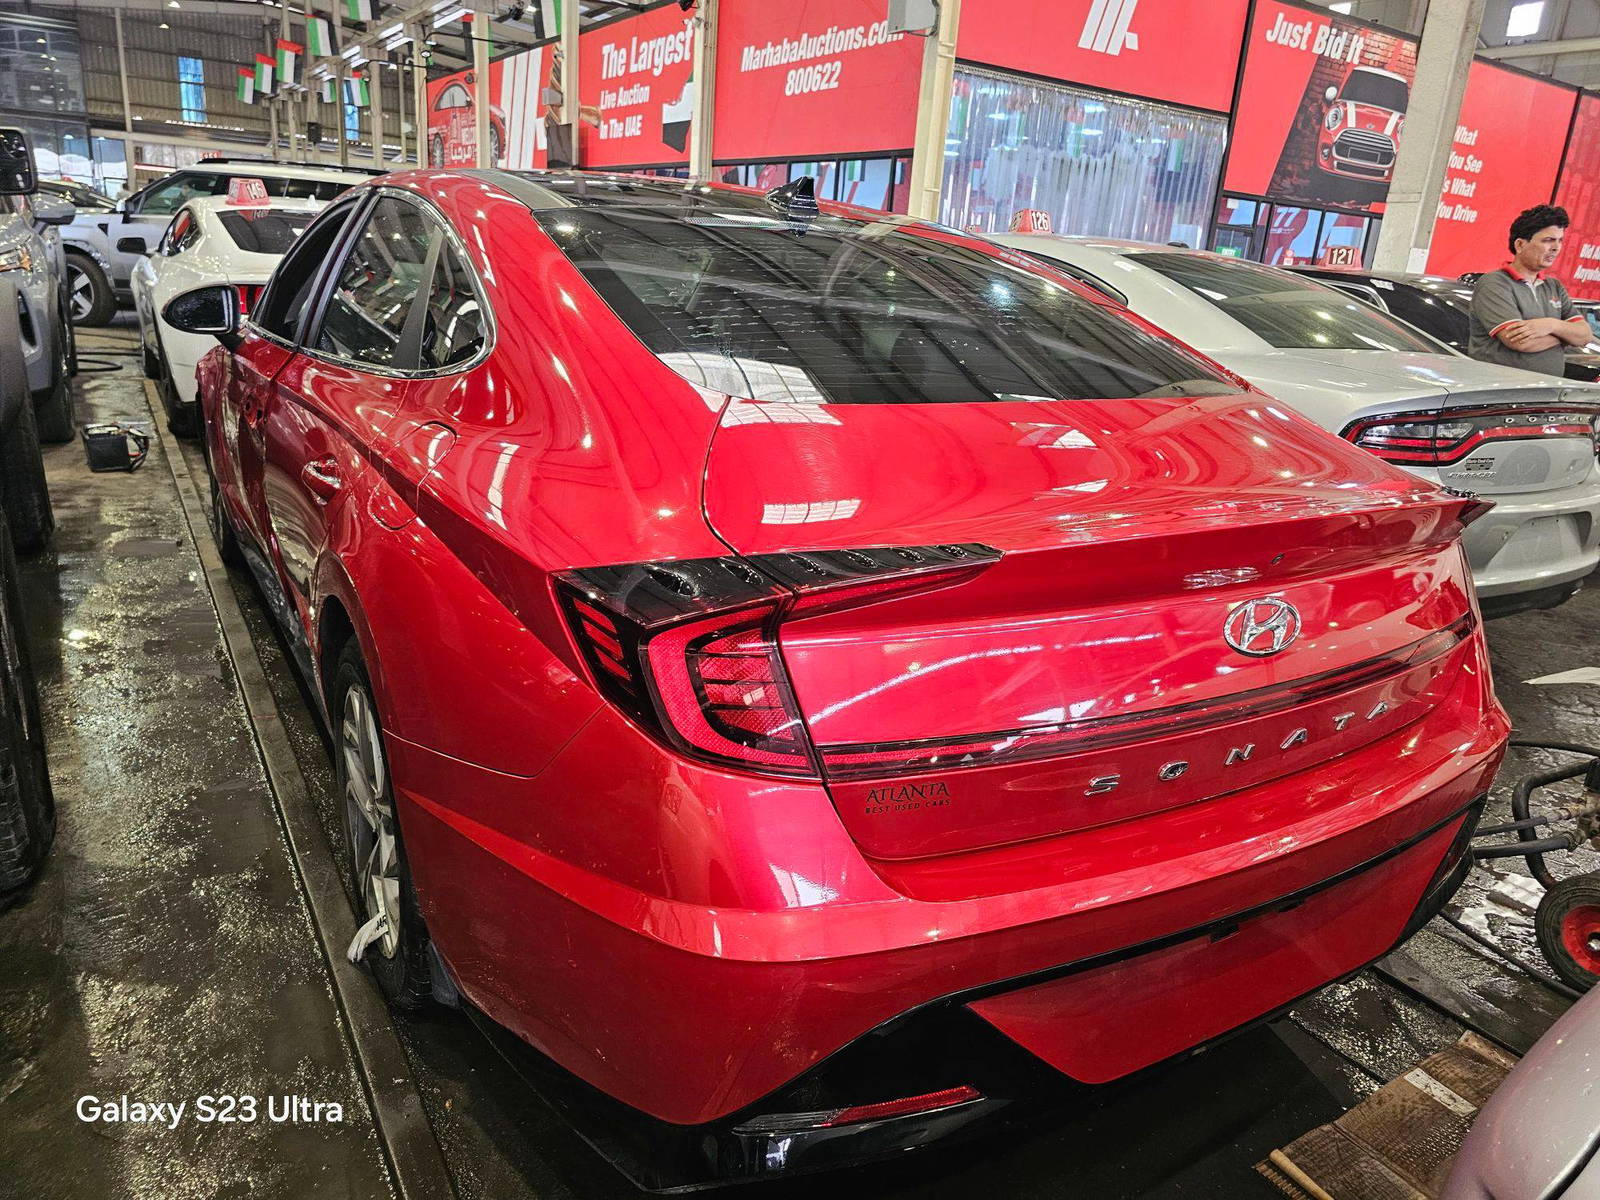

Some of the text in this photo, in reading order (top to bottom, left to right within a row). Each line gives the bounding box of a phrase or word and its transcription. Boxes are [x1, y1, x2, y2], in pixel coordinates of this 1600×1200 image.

[601, 18, 694, 80] The Largest
[741, 20, 904, 72] MarhabaAuctions.co
[1265, 12, 1364, 65] Just Bid It
[785, 61, 842, 96] 800622
[600, 83, 650, 111] Live Auction
[609, 118, 624, 138] The
[624, 114, 643, 138] UAE
[1454, 125, 1477, 145] What
[1464, 155, 1482, 173] See
[1450, 178, 1475, 197] What
[1452, 204, 1478, 223] Drive
[1332, 247, 1355, 265] 121
[1580, 243, 1596, 259] Bid
[1083, 700, 1388, 796] SONATA
[866, 782, 951, 804] ATLANTA
[865, 799, 950, 814] BEST USED CARS
